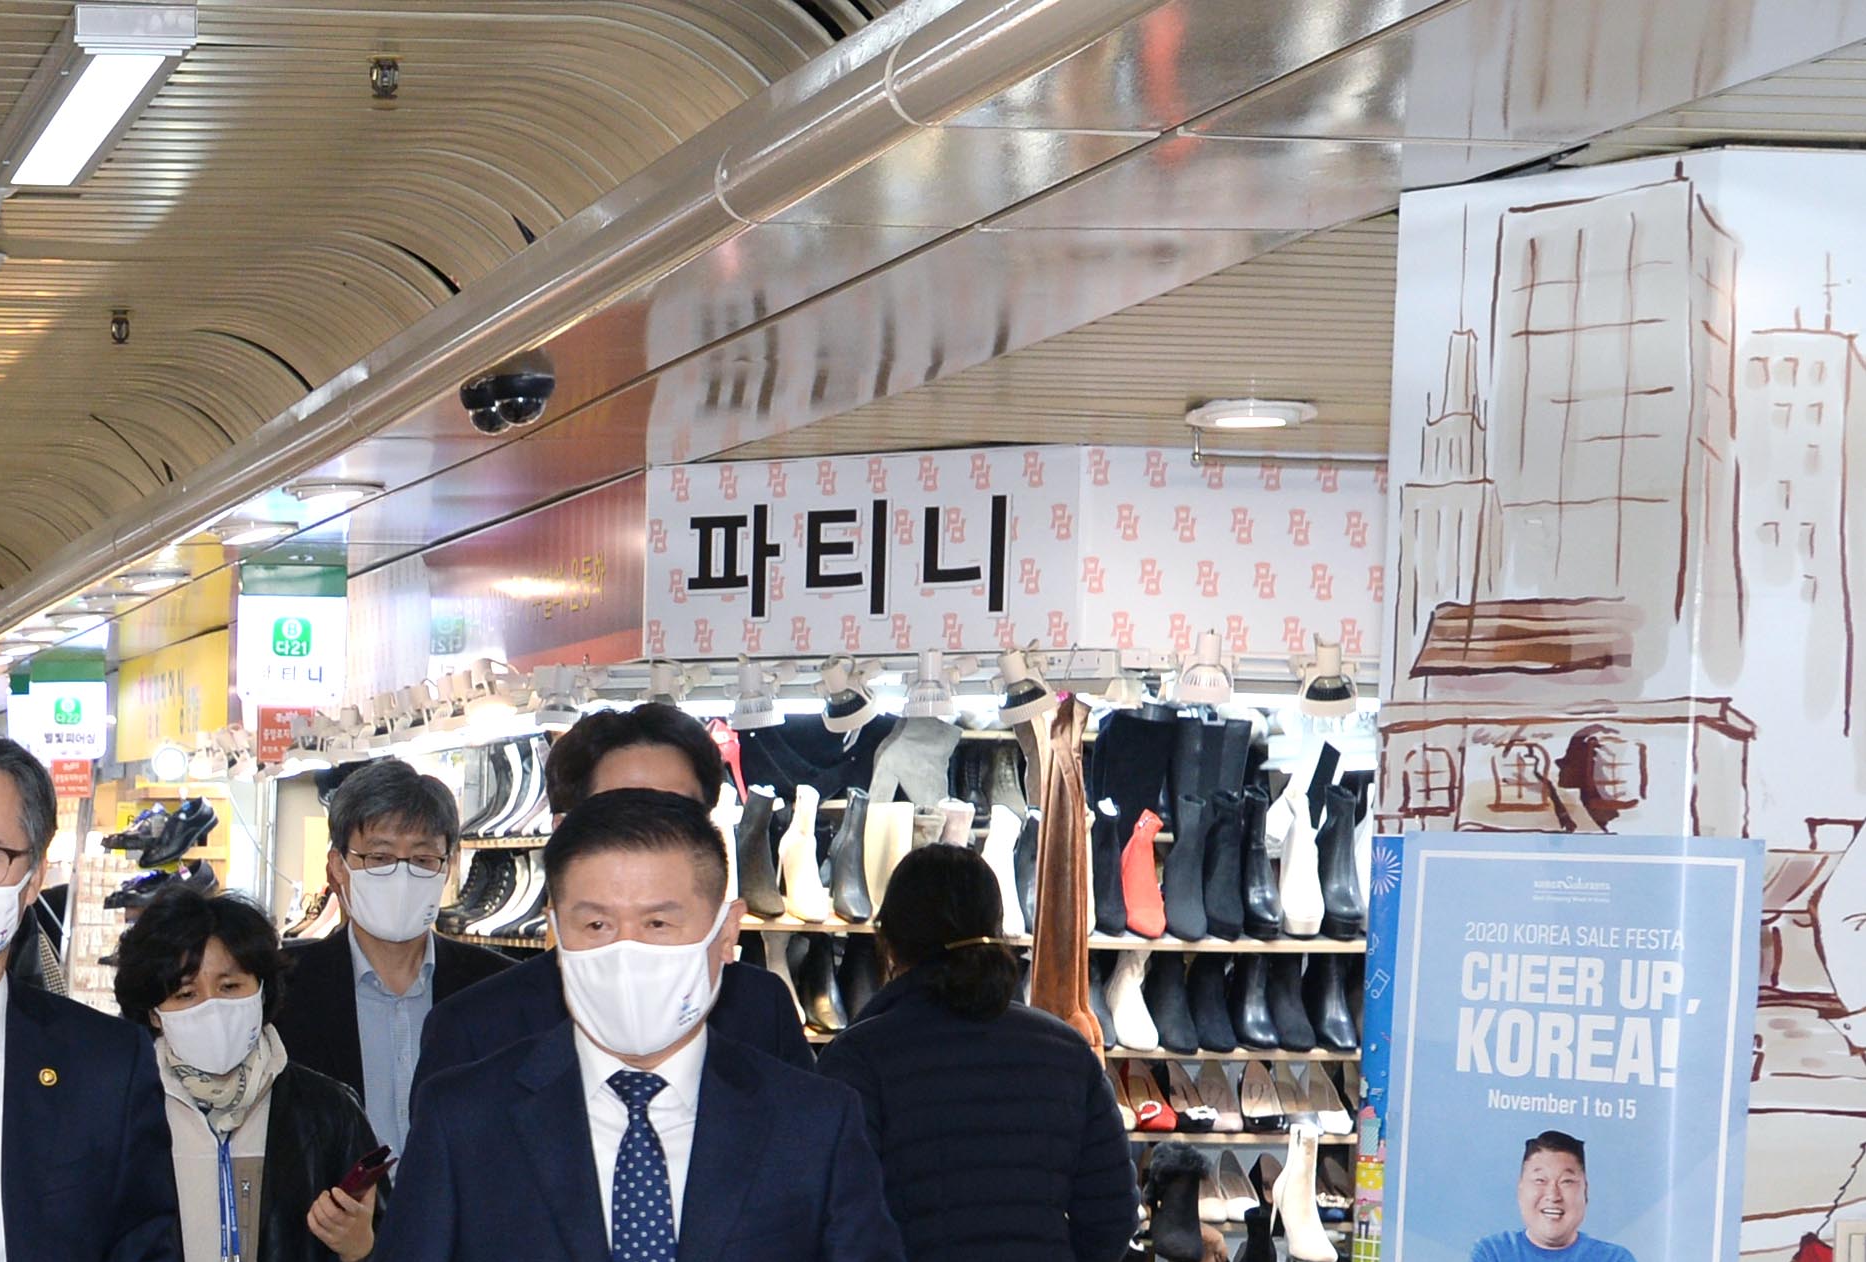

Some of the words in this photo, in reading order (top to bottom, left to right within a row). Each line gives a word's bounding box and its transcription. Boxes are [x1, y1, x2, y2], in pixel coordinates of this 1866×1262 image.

[687, 494, 1010, 620] 파티니
[275, 639, 308, 656] 다21
[1464, 921, 1508, 944] 2020
[1512, 923, 1572, 947] KOREA
[1575, 925, 1620, 949] SALE
[1625, 927, 1686, 951] FESTA
[1460, 950, 1606, 1008] CHEER
[1618, 957, 1702, 1015] UP,
[1455, 1005, 1681, 1089] KOREA!
[1487, 1088, 1578, 1115] November
[1581, 1095, 1589, 1117] 1
[1594, 1096, 1614, 1119] to
[1617, 1097, 1638, 1120] 15
